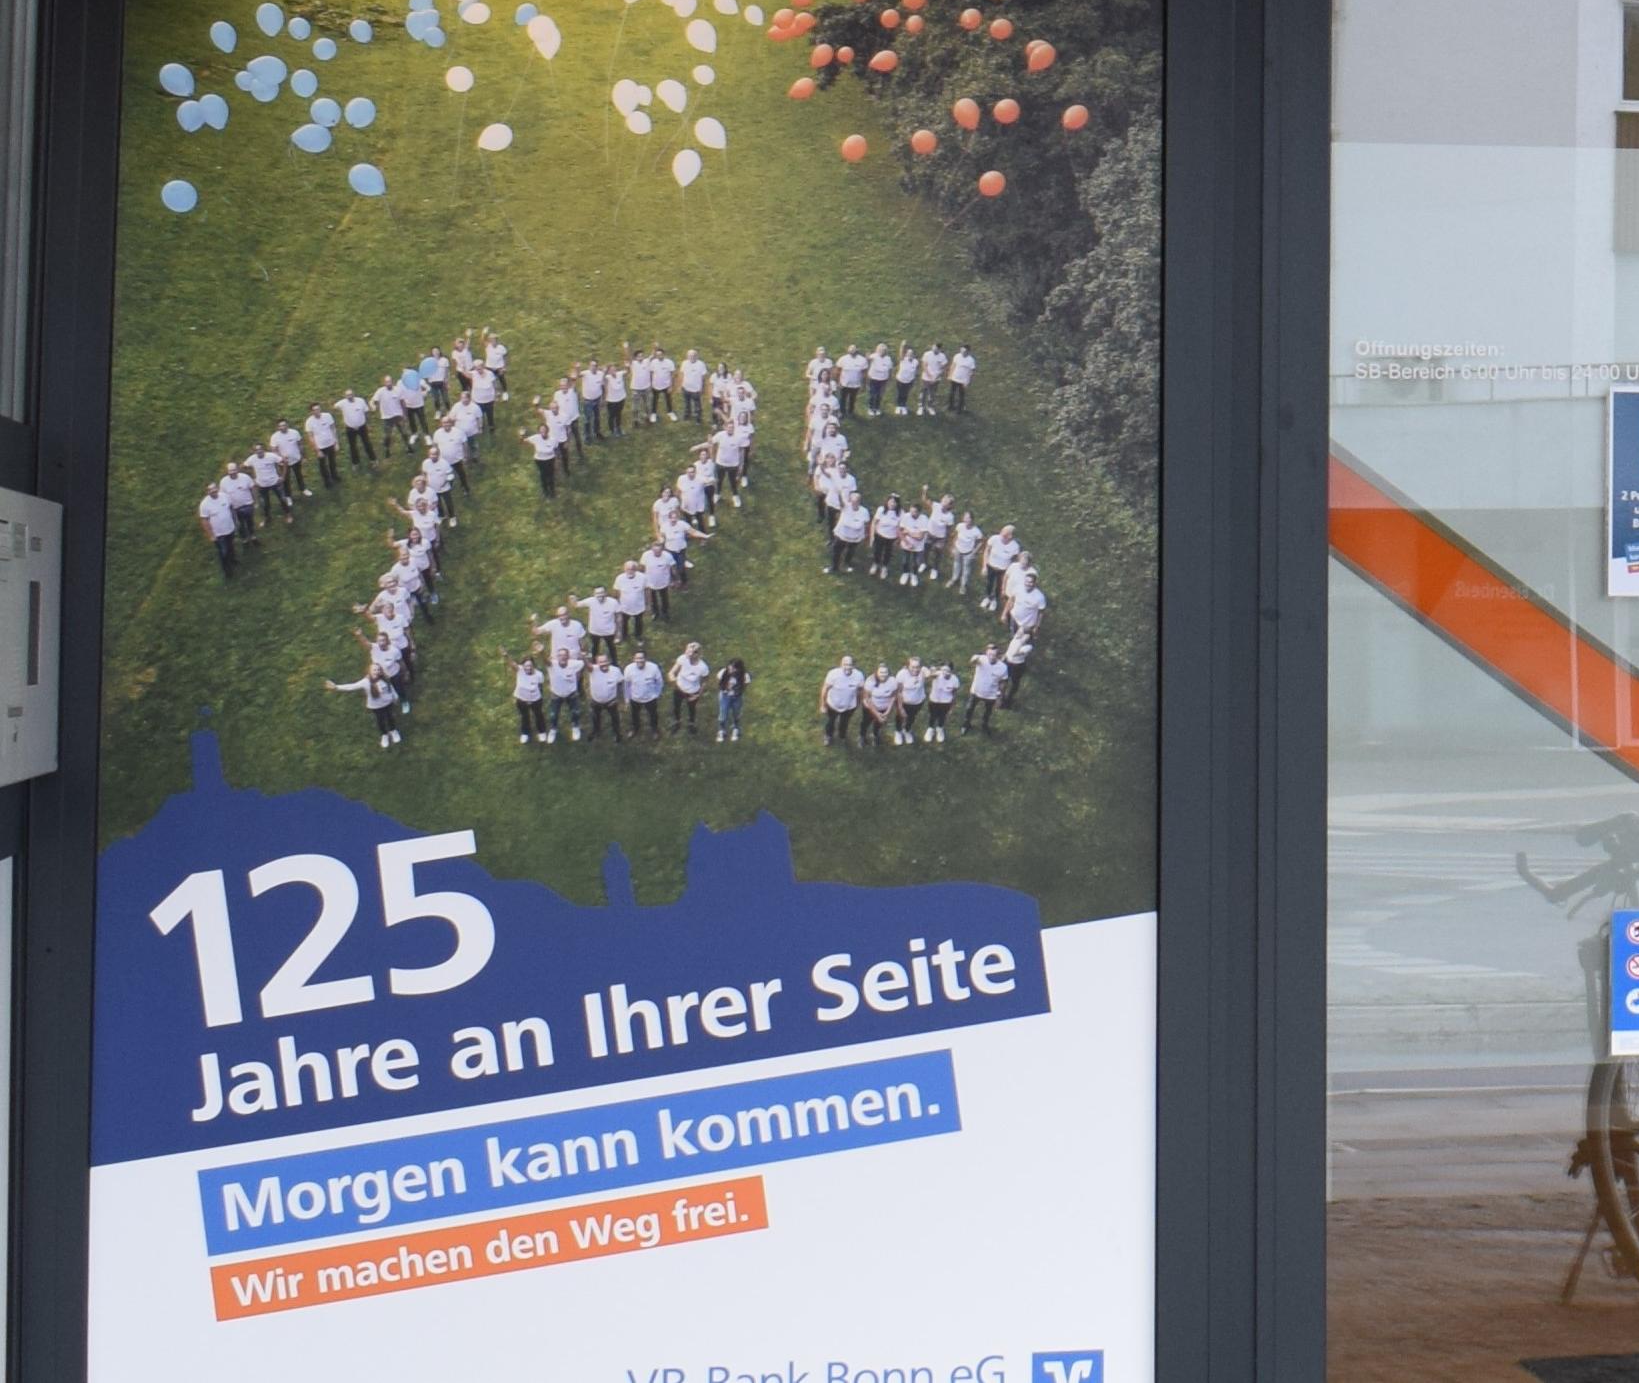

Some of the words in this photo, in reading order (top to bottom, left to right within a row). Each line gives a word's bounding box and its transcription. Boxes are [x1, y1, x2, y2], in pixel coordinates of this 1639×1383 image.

[1355, 363, 1454, 379] SB-Bereich
[1505, 363, 1537, 379] Uhr
[1542, 362, 1567, 379] bis
[1621, 490, 1628, 500] 2
[148, 829, 497, 1028] 125
[190, 1032, 420, 1124] Jahre
[452, 1019, 555, 1080] an
[586, 975, 784, 1061] Ihrer
[813, 935, 1017, 1024] Seite
[222, 1148, 467, 1236] Morgen
[487, 1117, 640, 1190] kann
[661, 1076, 941, 1163] kommen.
[231, 1262, 304, 1309] Wir
[317, 1237, 474, 1296] machen
[485, 1220, 560, 1266] den
[568, 1207, 661, 1254] Weg
[673, 1190, 750, 1235] frei.
